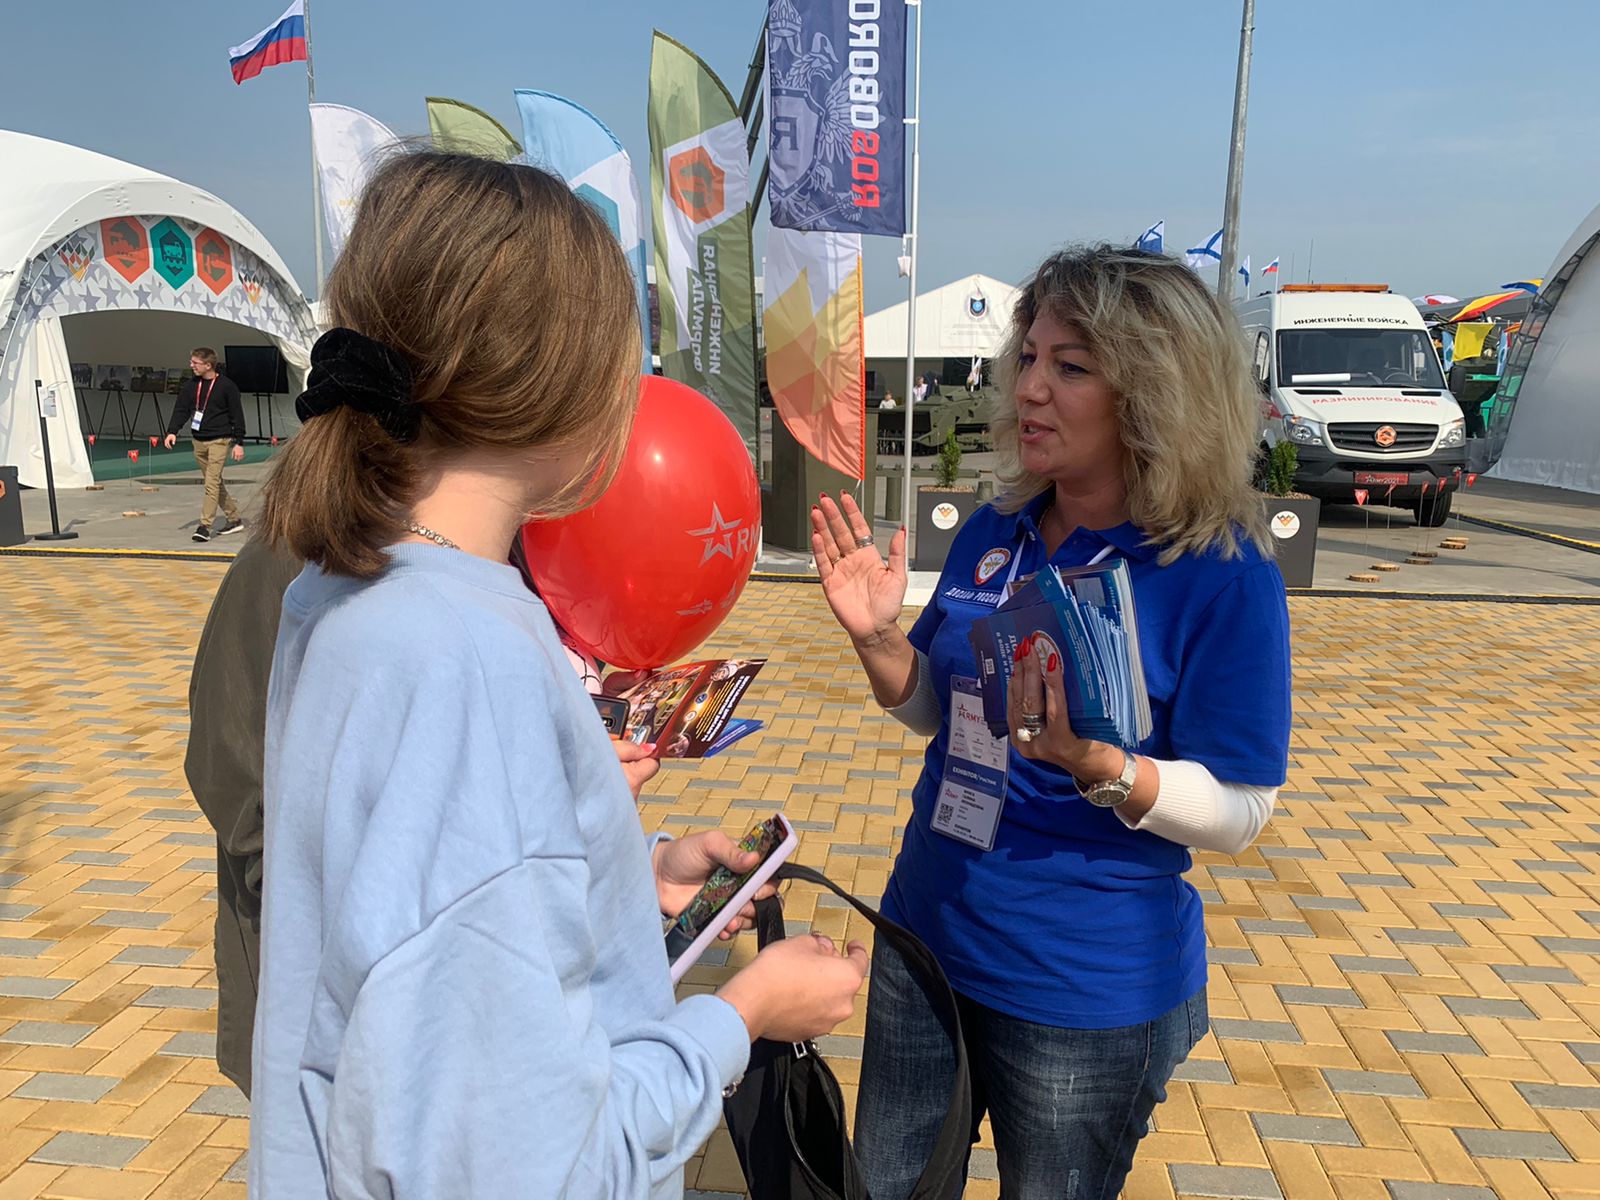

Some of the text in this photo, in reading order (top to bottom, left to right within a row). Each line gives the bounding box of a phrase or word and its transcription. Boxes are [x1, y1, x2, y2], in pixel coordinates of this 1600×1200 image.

[1293, 316, 1409, 326] ИНЖЕНЕРНЫЕ ВОЙСКА
[1312, 396, 1438, 406] РАЗМИНИРОВАНИЕ
